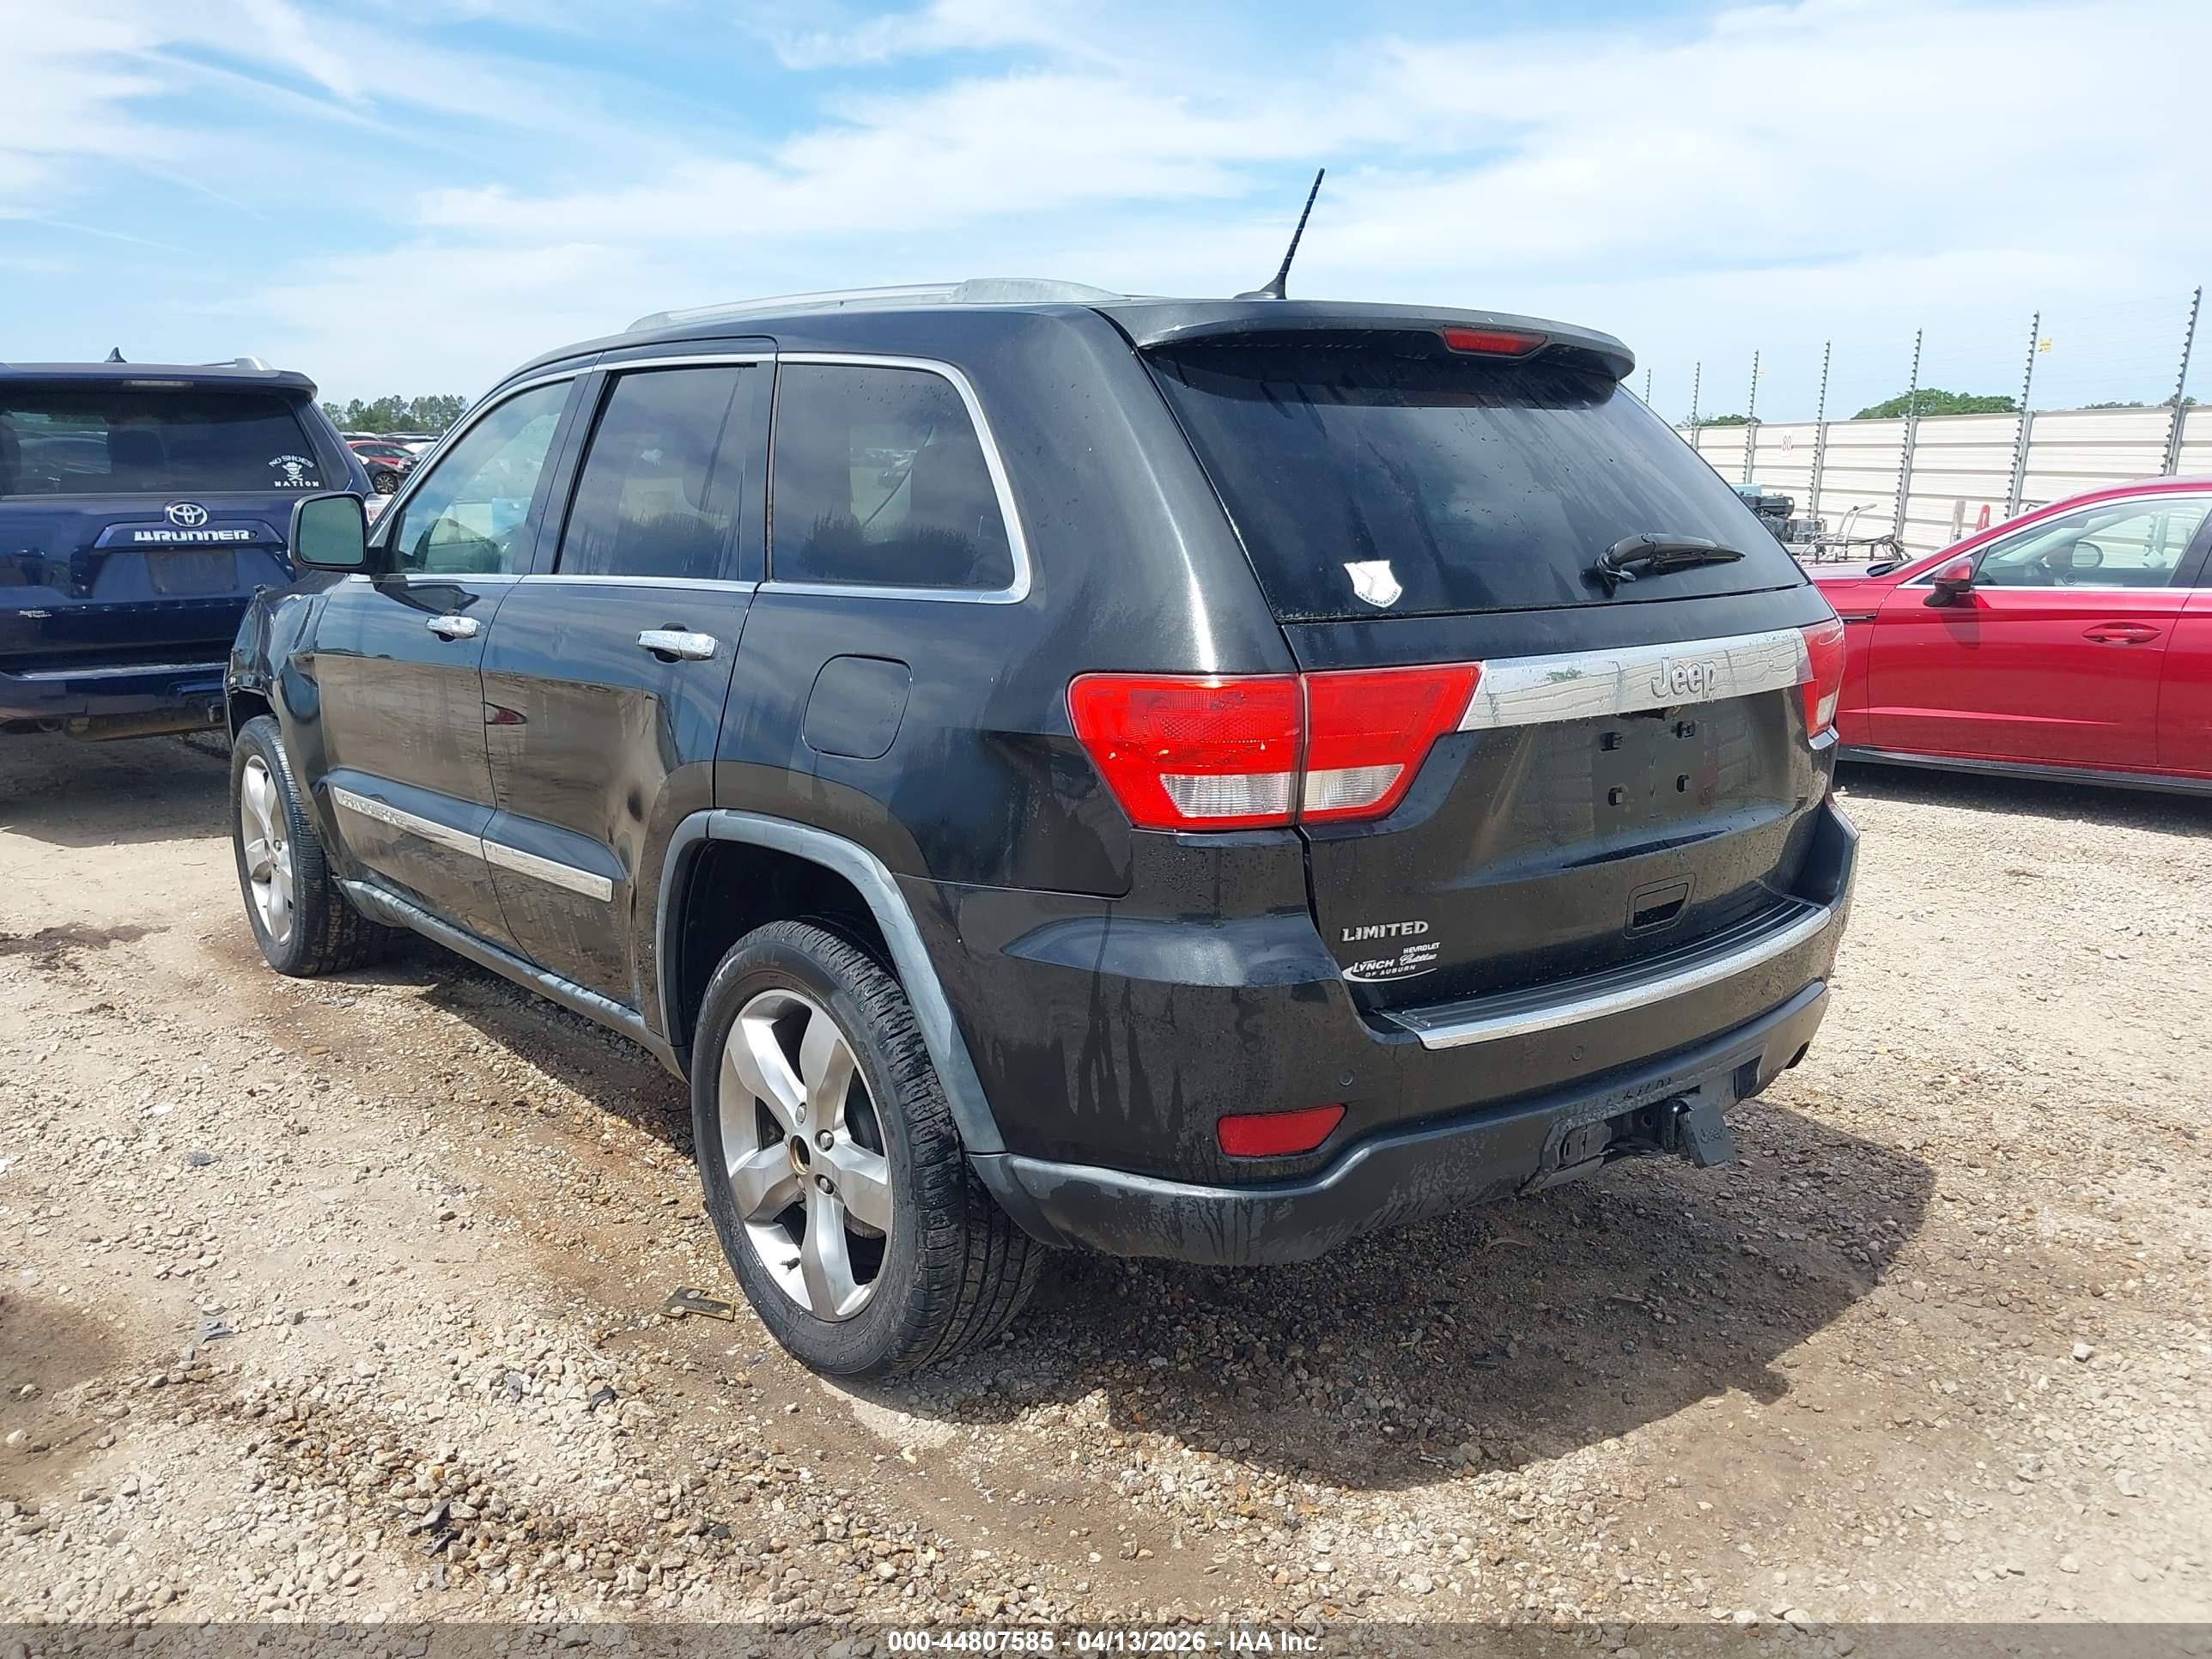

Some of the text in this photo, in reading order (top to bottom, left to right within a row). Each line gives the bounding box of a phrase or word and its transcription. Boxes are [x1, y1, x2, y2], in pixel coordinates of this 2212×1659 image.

[269, 454, 315, 468] NO SHOES
[134, 529, 251, 543] 4RUNNER
[1650, 656, 1718, 700] Jeep
[1340, 920, 1429, 942] LIMITED
[1352, 958, 1395, 974] LYNCH
[1379, 964, 1417, 976] AUBURN
